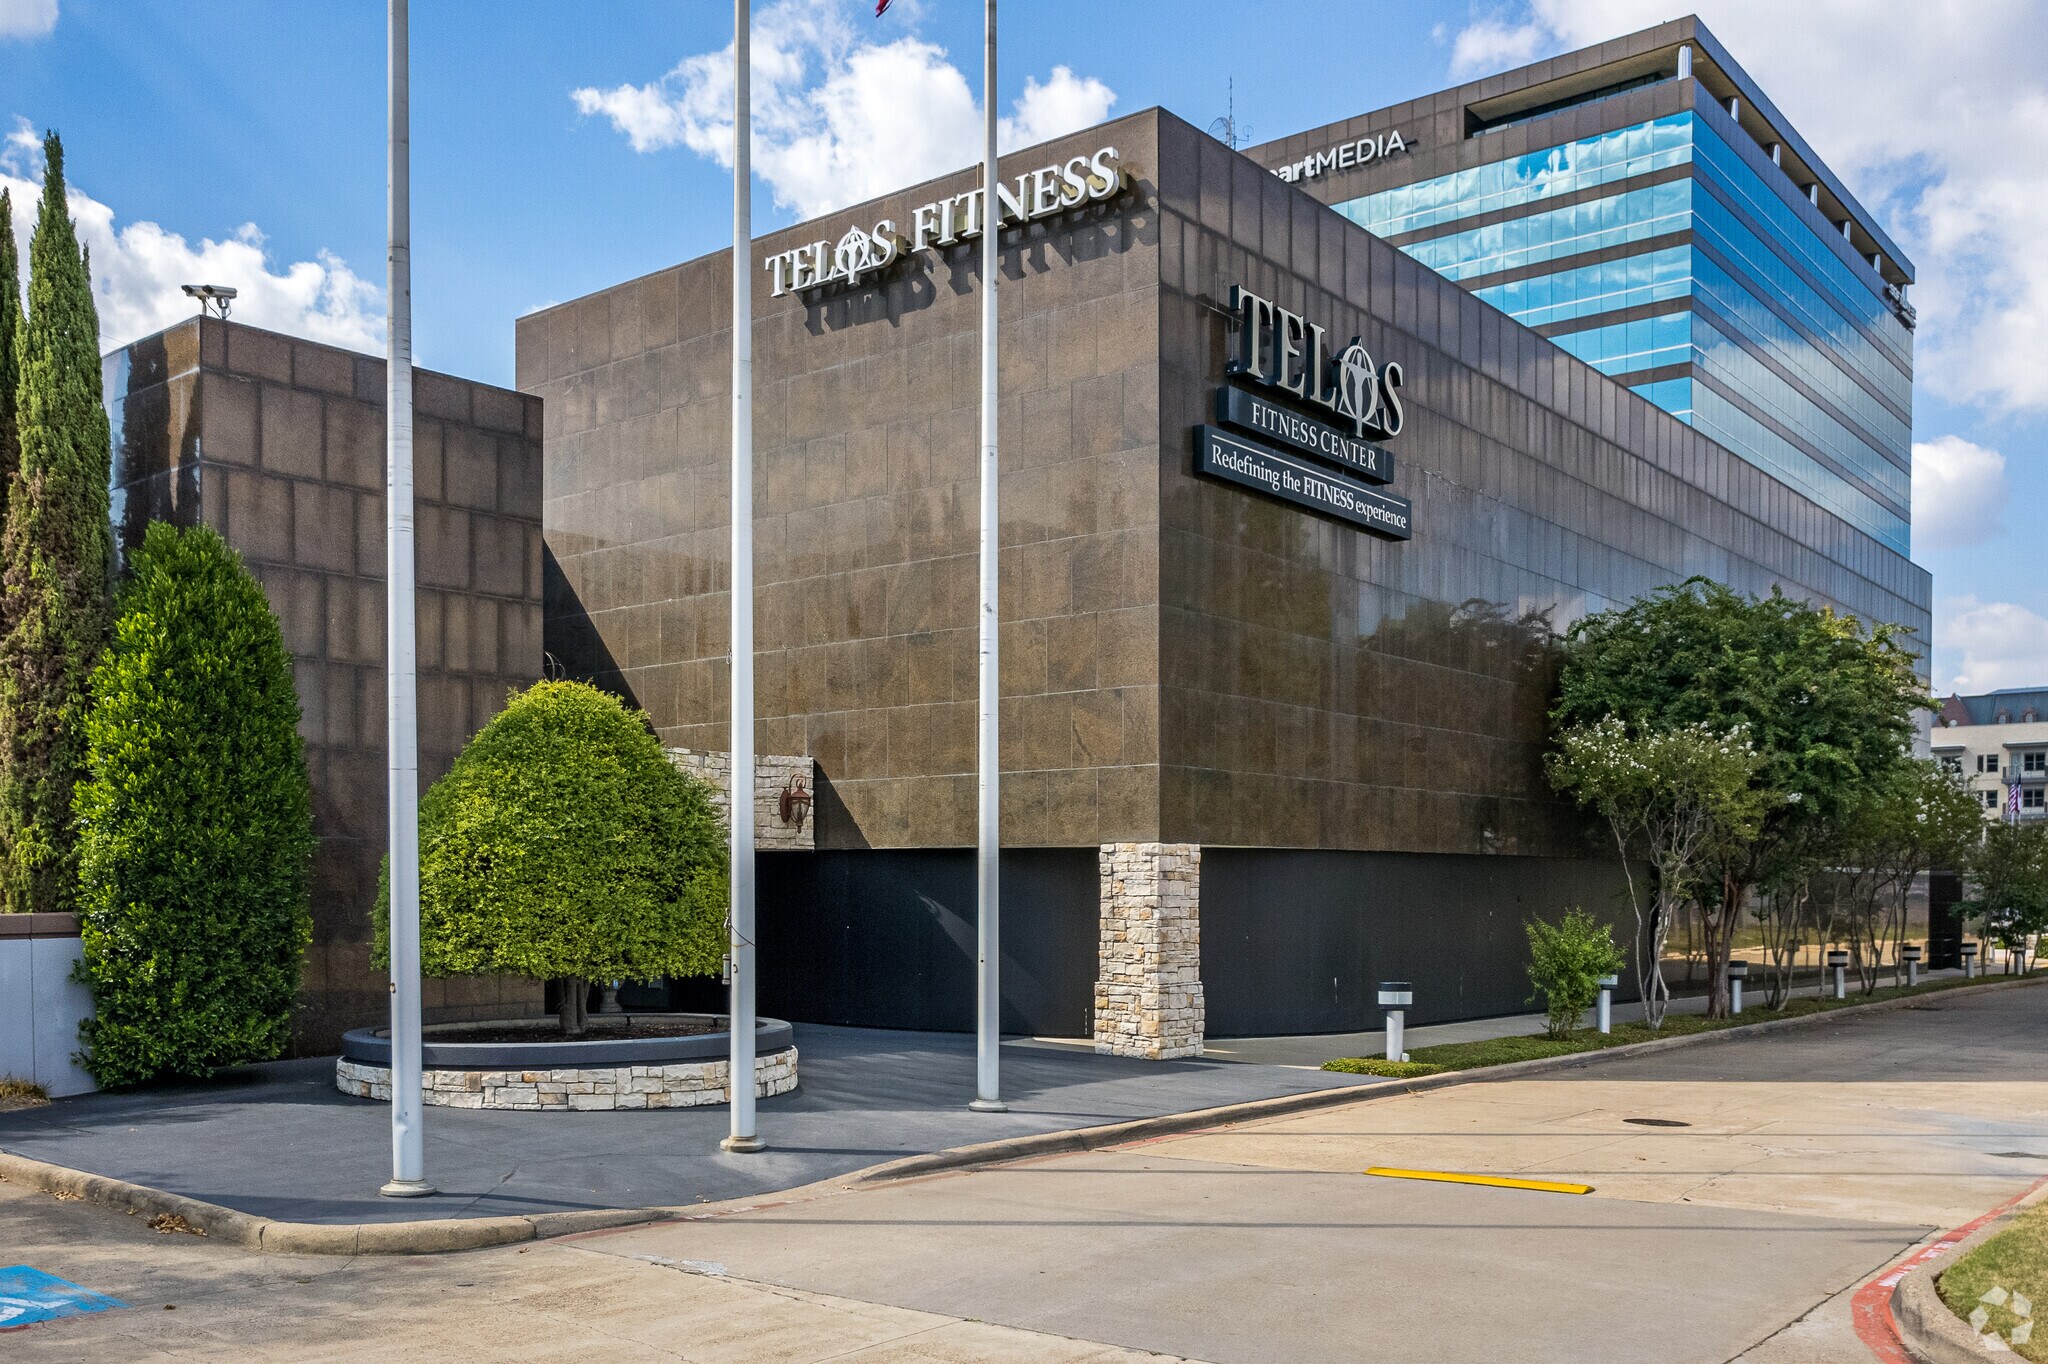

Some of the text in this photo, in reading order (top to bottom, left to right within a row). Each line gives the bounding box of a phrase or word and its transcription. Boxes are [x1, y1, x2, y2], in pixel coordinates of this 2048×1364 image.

[1269, 130, 1406, 183] artMEDIA
[764, 146, 1119, 298] TELOS FITNESS
[1237, 285, 1405, 438] TELOS
[1252, 402, 1377, 471] FITNESS CENTER
[1211, 444, 1407, 529] Redefining the FITNESS experience
